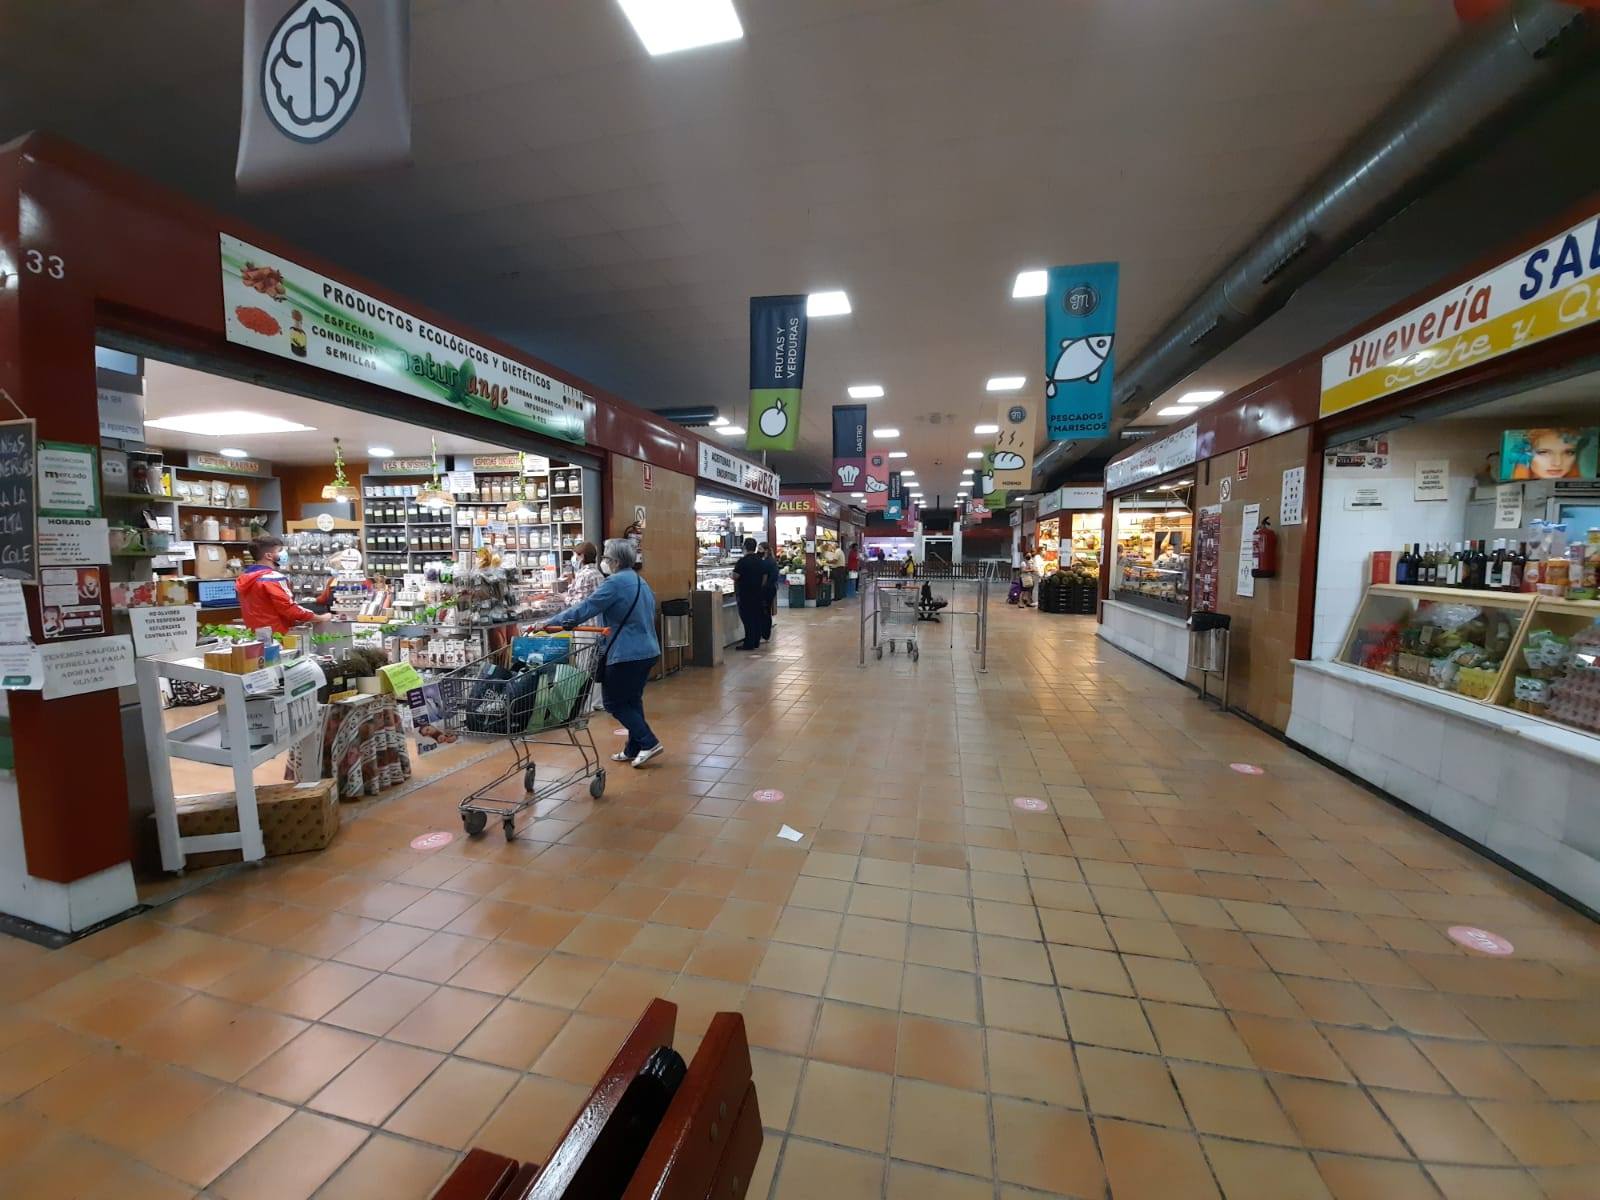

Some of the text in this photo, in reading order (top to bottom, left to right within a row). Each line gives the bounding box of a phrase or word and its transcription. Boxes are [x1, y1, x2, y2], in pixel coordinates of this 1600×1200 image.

[26, 249, 64, 279] 33
[311, 325, 383, 356] CONDIMENT
[322, 282, 551, 391] PRODUCTOS ECOLÓGICOS Y DIETÉTICOS
[324, 313, 375, 340] ESPECIAS
[1348, 284, 1493, 377] Huevería
[325, 345, 377, 370] SEMILLAS
[774, 336, 785, 379] FRUTAS
[787, 317, 799, 379] VERDURAS
[1050, 412, 1104, 421] PESCADOS
[1053, 422, 1107, 432] MARISCOS
[47, 518, 92, 526] HORARIO
